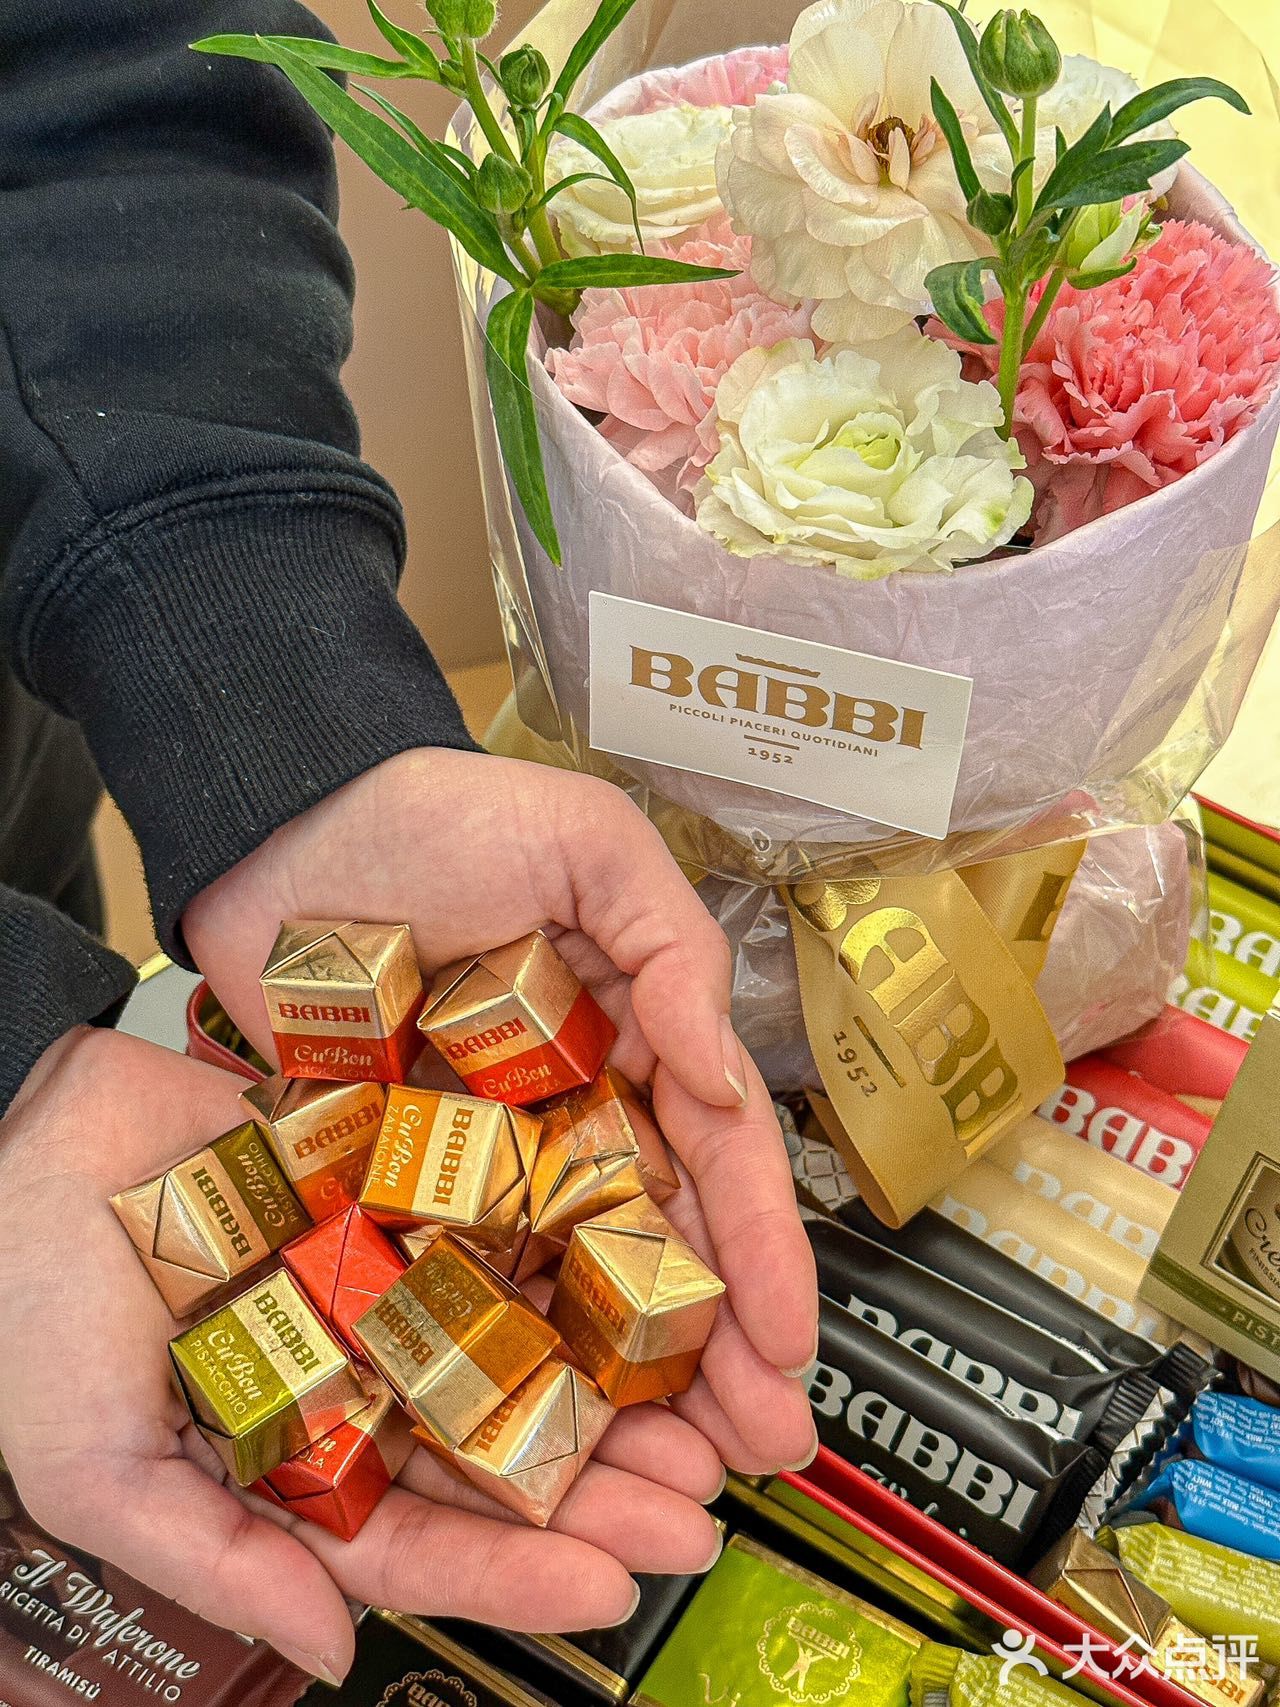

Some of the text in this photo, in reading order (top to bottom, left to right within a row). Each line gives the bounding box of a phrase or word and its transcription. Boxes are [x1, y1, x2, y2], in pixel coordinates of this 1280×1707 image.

[629, 645, 928, 750] BABBI
[669, 703, 879, 758] PICCOLI PIACERI QUOTIDIANI
[748, 747, 794, 765] 1952
[278, 1002, 371, 1023] BABBI
[445, 1016, 528, 1061] BABBI
[294, 1044, 374, 1066] CuBon
[482, 1064, 552, 1098] CuBon
[832, 1030, 878, 1098] 1952
[292, 1102, 382, 1159] BABBI
[370, 1105, 399, 1184] ZABAIONE
[384, 1104, 422, 1190] CuBon
[432, 1107, 475, 1206] BABBI
[191, 1166, 253, 1258] BABBI
[207, 1329, 263, 1401] CuBon
[253, 1290, 322, 1375] BABBI
[374, 1296, 435, 1368] BABBI
[190, 1339, 248, 1415] PISTACCHIO
[475, 1383, 529, 1453] BBI
[0, 1581, 91, 1646] RICETTA DI
[14, 1549, 201, 1679] Il Waferone
[102, 1649, 182, 1701] ATTILIO
